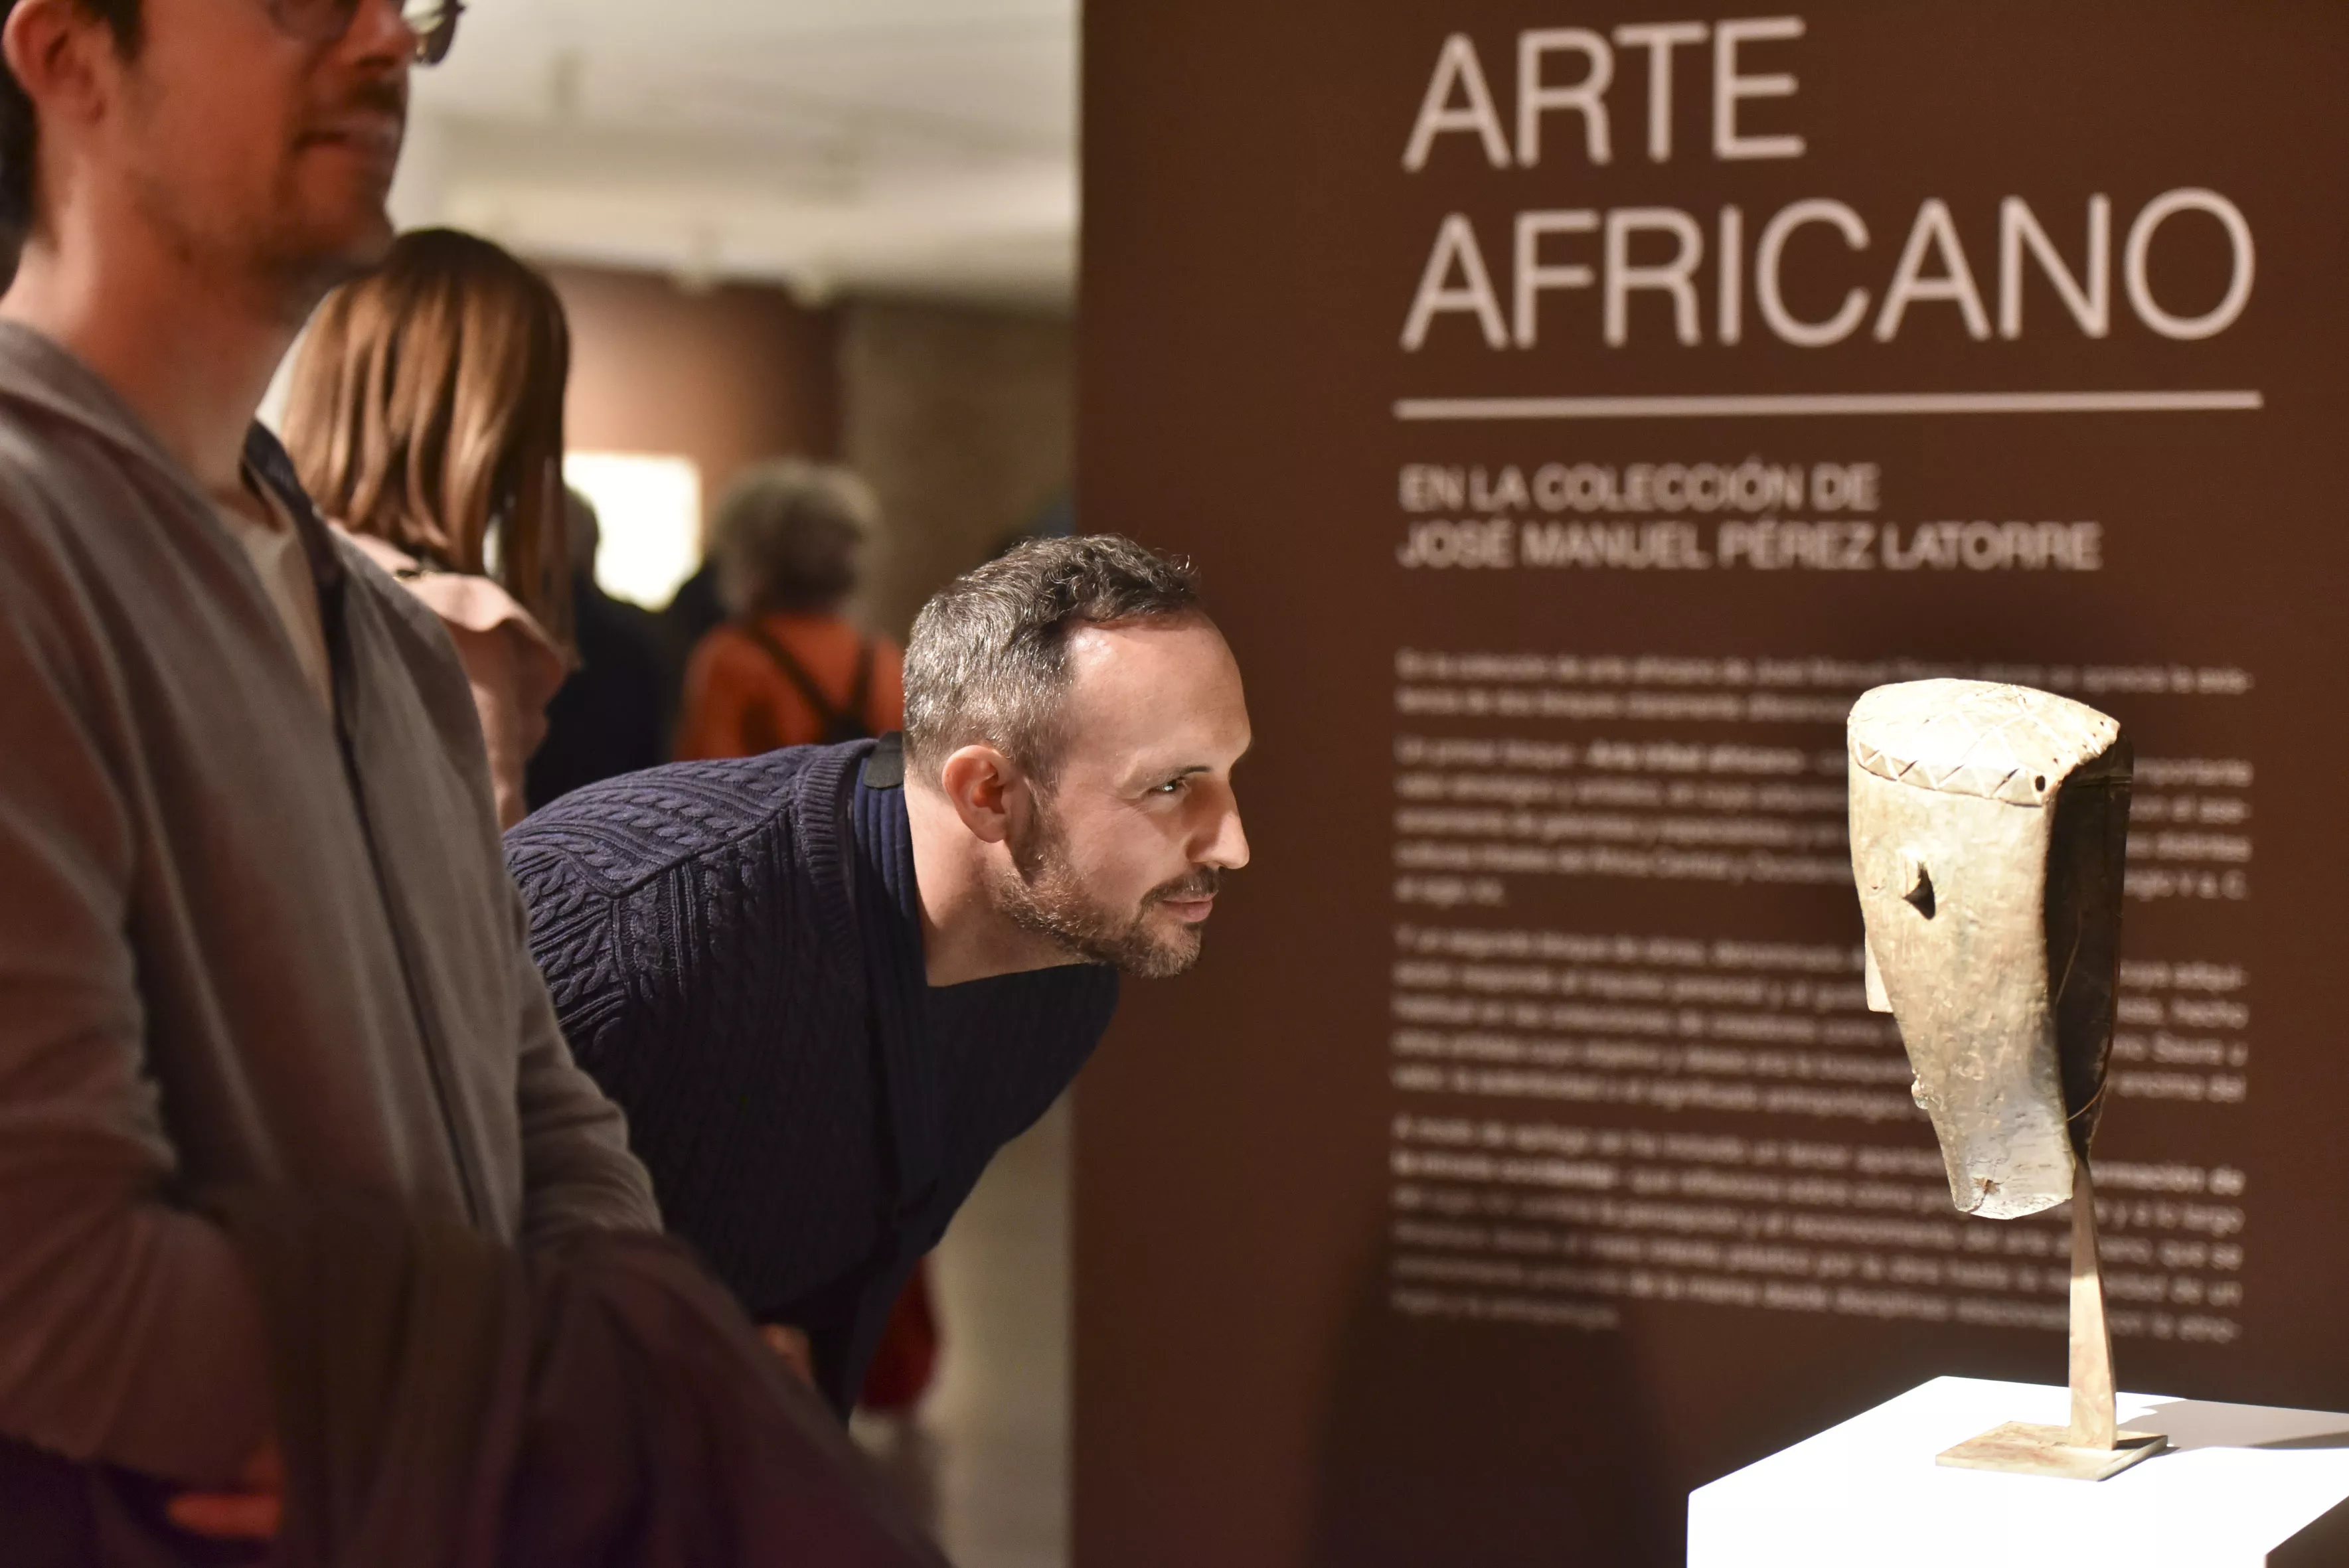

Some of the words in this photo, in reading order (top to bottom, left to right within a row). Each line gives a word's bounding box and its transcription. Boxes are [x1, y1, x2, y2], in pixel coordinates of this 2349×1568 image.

[1402, 16, 1807, 172] ARTE
[1401, 187, 2256, 350] AFRICANO
[1398, 463, 1465, 512] EN
[1469, 465, 1530, 512] LA
[1532, 456, 1805, 512] COLECCIÓN
[1811, 463, 1879, 511] DE
[1397, 514, 1514, 570] JOSÉ
[1522, 520, 1711, 570] MANUEL
[1718, 512, 1876, 570] PÉREZ
[1881, 520, 2102, 571] LATORRE
